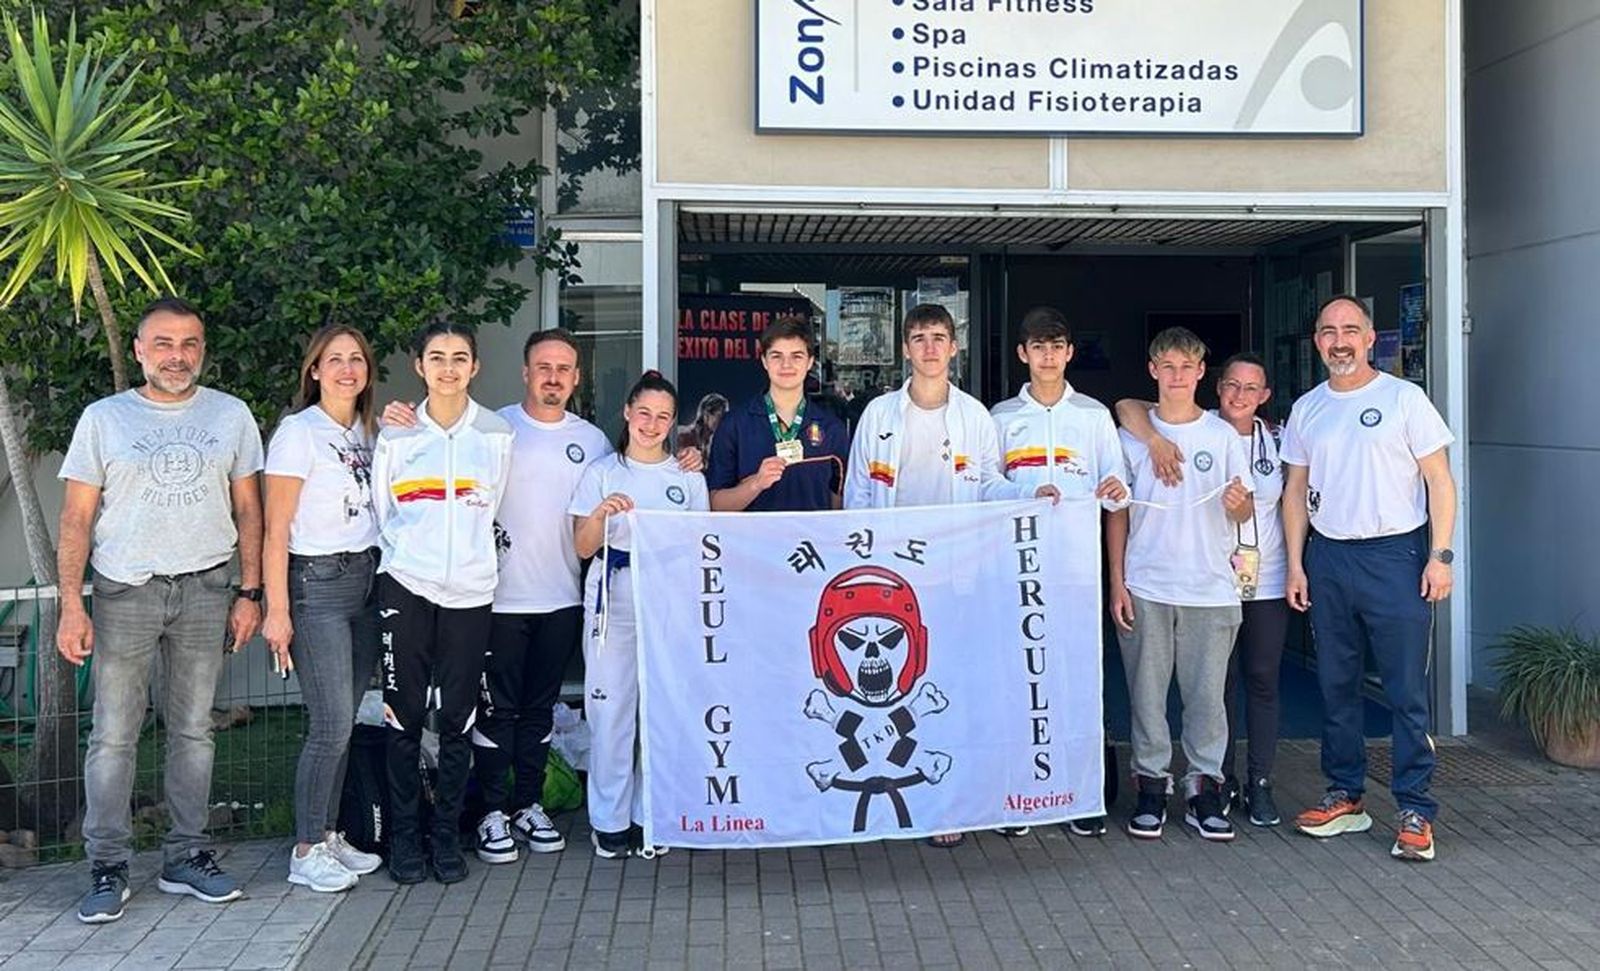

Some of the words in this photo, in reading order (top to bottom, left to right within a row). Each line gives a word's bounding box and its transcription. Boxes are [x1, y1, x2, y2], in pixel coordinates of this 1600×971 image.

[912, 0, 974, 12] Sala
[988, 0, 1094, 13] Fitness
[912, 22, 966, 49] Spa
[912, 56, 1037, 79] Piscinas
[1049, 57, 1239, 81] Climatizadas
[912, 88, 1015, 112] Unidad
[1028, 90, 1202, 118] Fisioterapia
[700, 310, 747, 332] CLASE
[724, 338, 751, 359] DEL
[131, 427, 165, 454] NEW
[175, 425, 219, 447] YORK
[140, 483, 210, 507] HILFIGER
[787, 527, 927, 574] 태권도
[701, 533, 729, 665] SEUL
[1013, 515, 1053, 782] HERCULES
[861, 724, 896, 749] TKD
[704, 704, 741, 806] GYM
[1002, 790, 1075, 815] Algeciras
[680, 815, 705, 832] La
[711, 814, 765, 832] Linea
